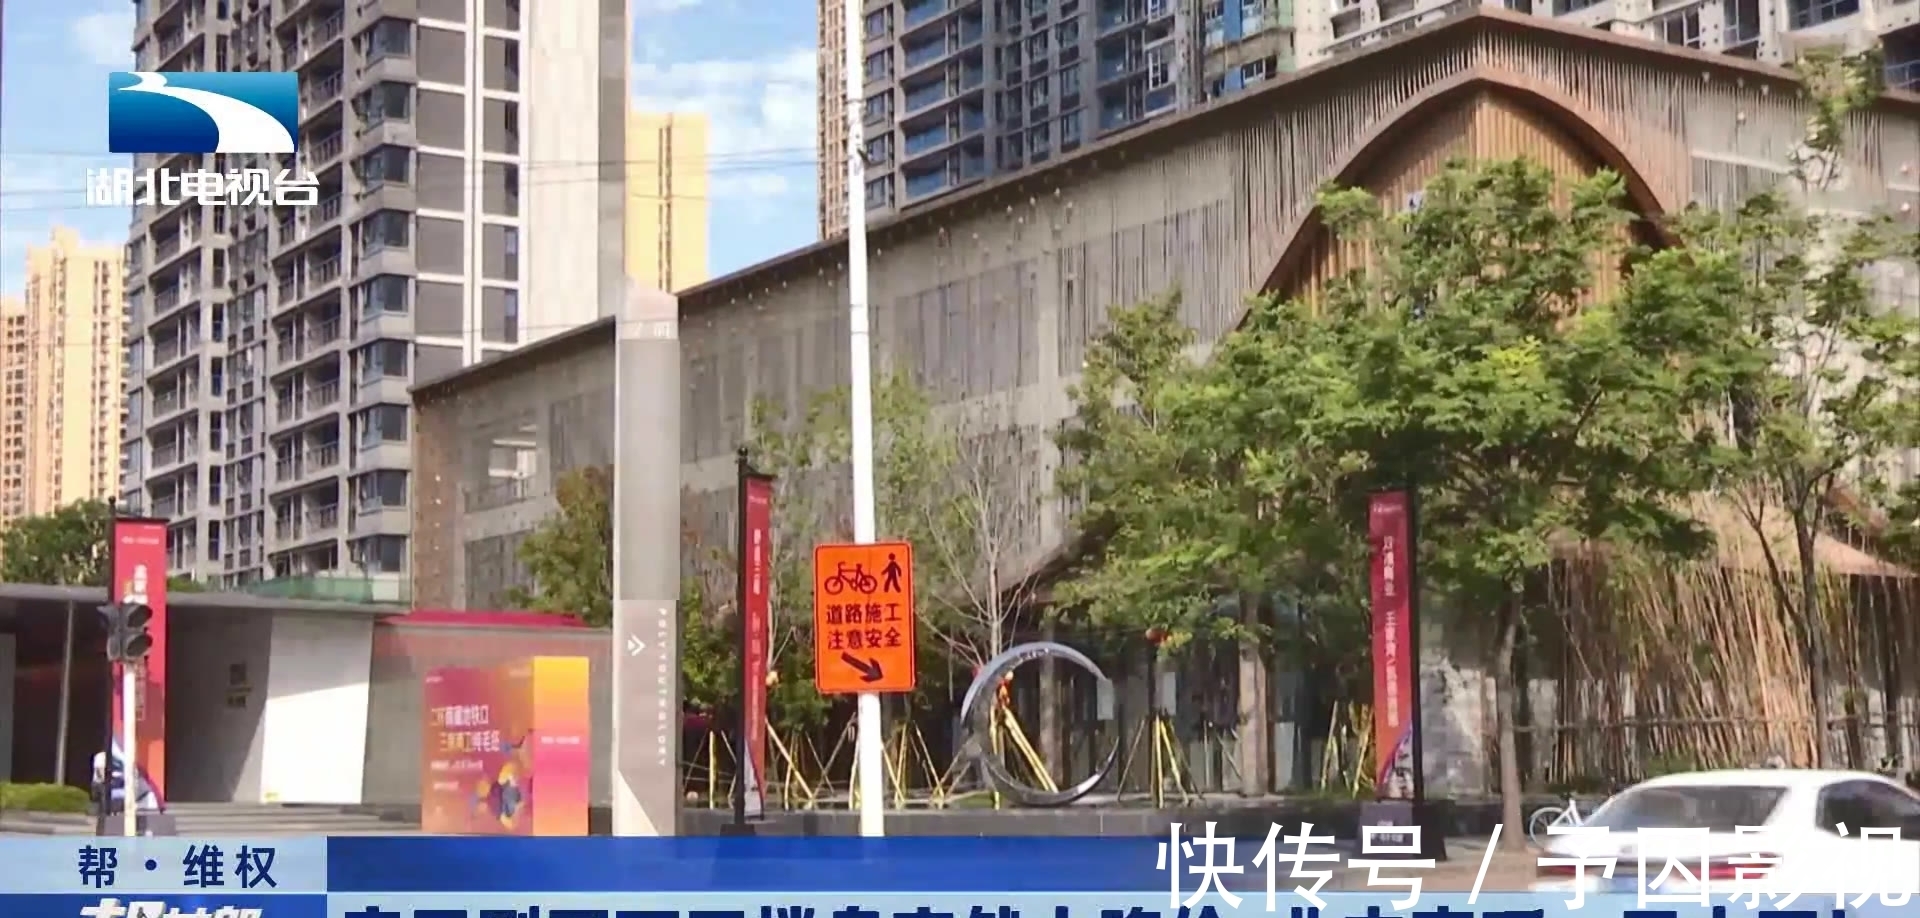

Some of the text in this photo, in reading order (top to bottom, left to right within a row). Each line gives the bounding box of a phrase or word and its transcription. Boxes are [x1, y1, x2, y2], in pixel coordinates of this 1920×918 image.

[826, 602, 902, 625] 道路施工
[827, 626, 902, 650] 注意安全
